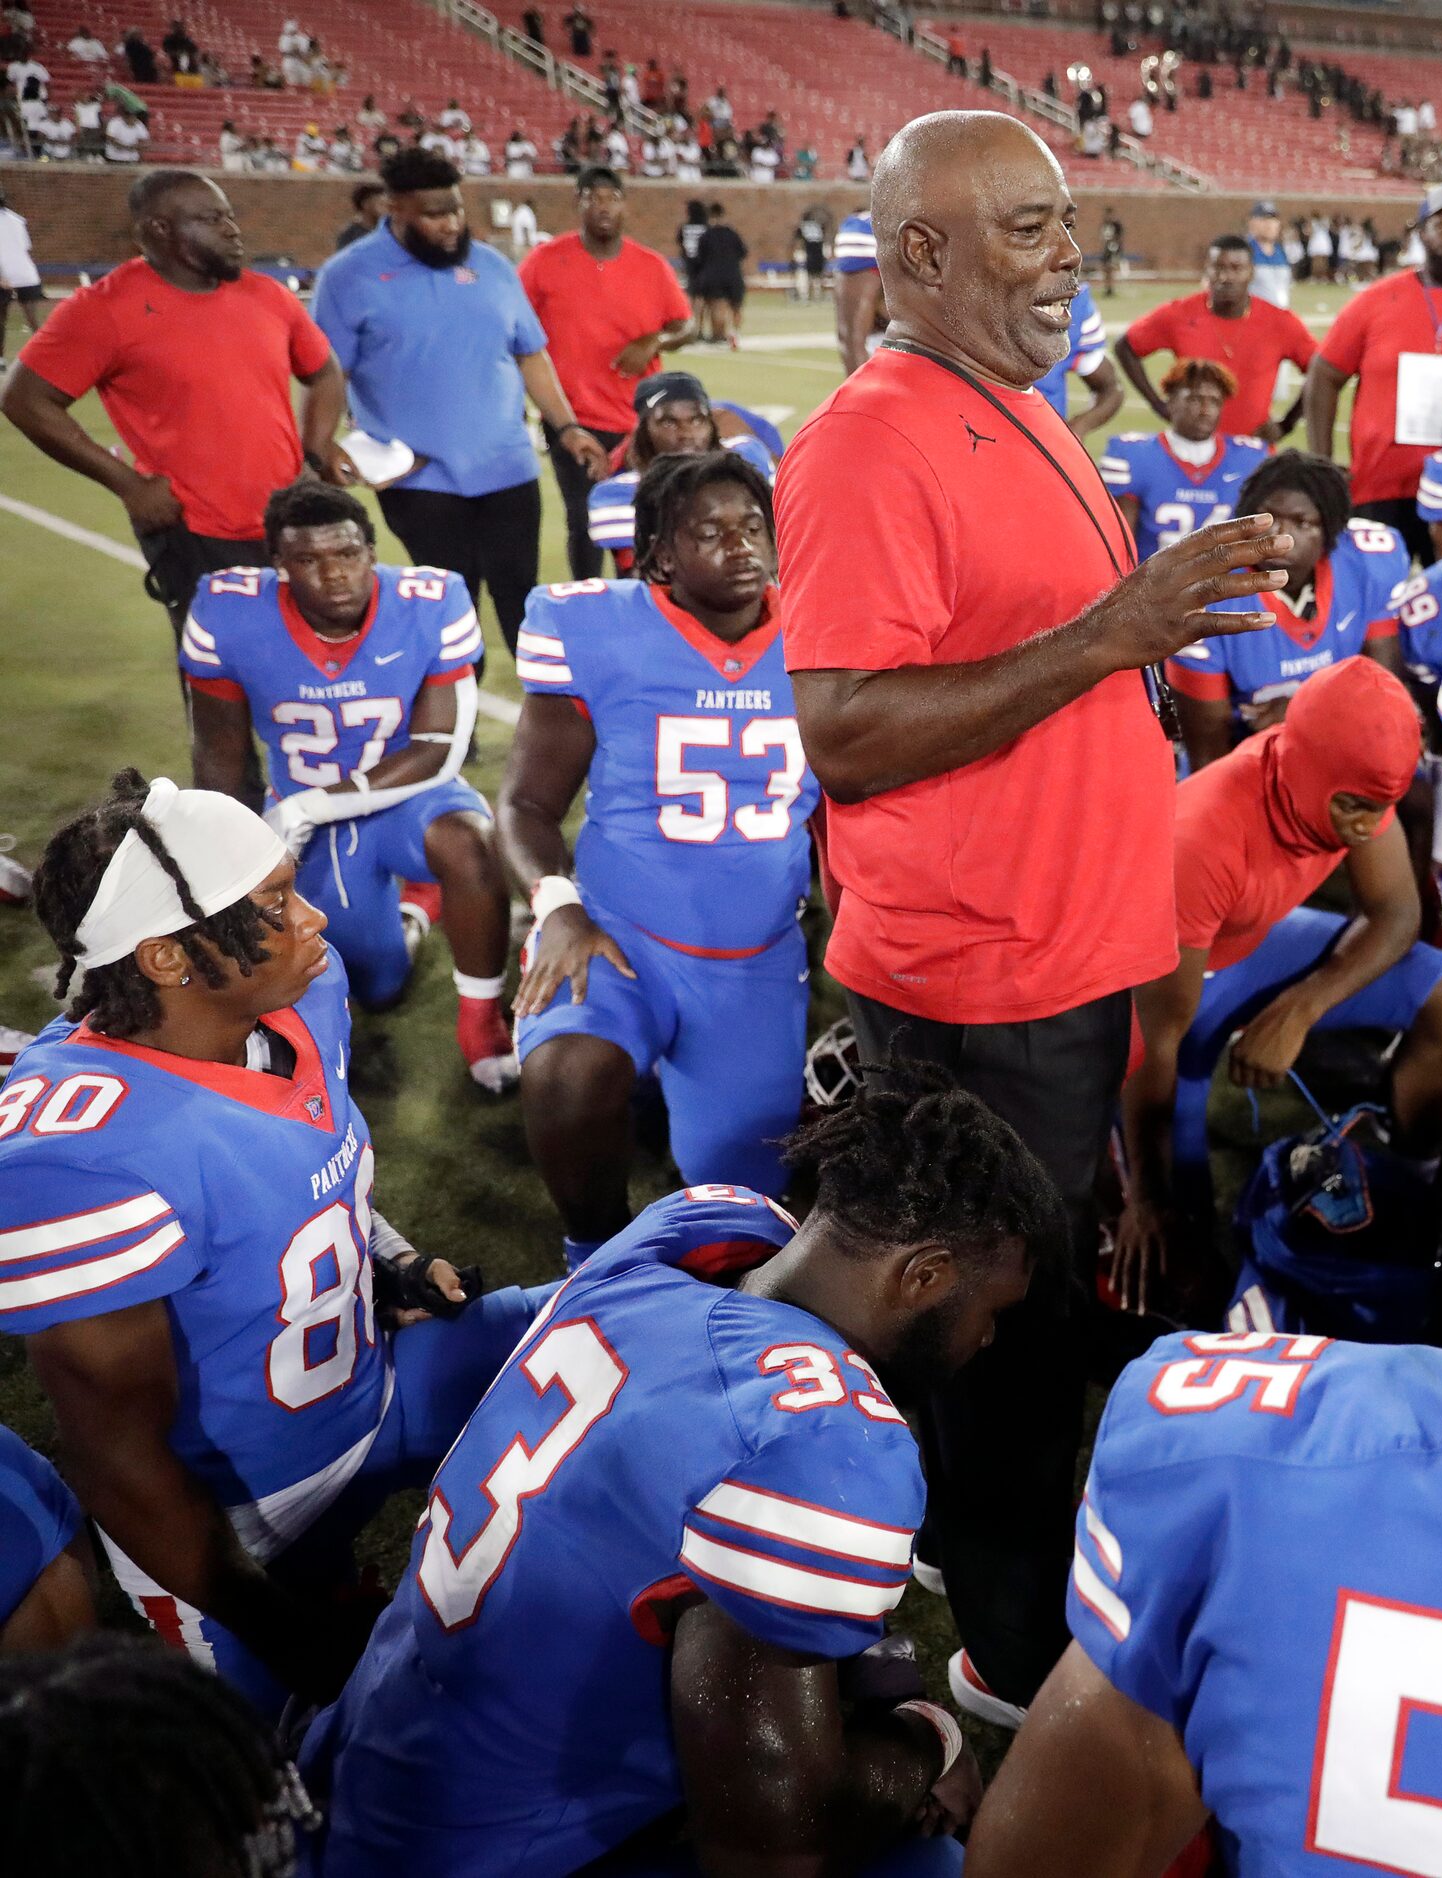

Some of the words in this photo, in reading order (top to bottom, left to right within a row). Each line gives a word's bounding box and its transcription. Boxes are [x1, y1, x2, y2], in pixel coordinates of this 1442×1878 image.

[299, 680, 367, 699] PANTHERS
[695, 689, 772, 710] PANTHERS
[271, 696, 403, 788] 27
[655, 713, 808, 844] 53
[0, 1071, 132, 1138] 80
[756, 1341, 911, 1428] 33
[1147, 1330, 1338, 1419] 55
